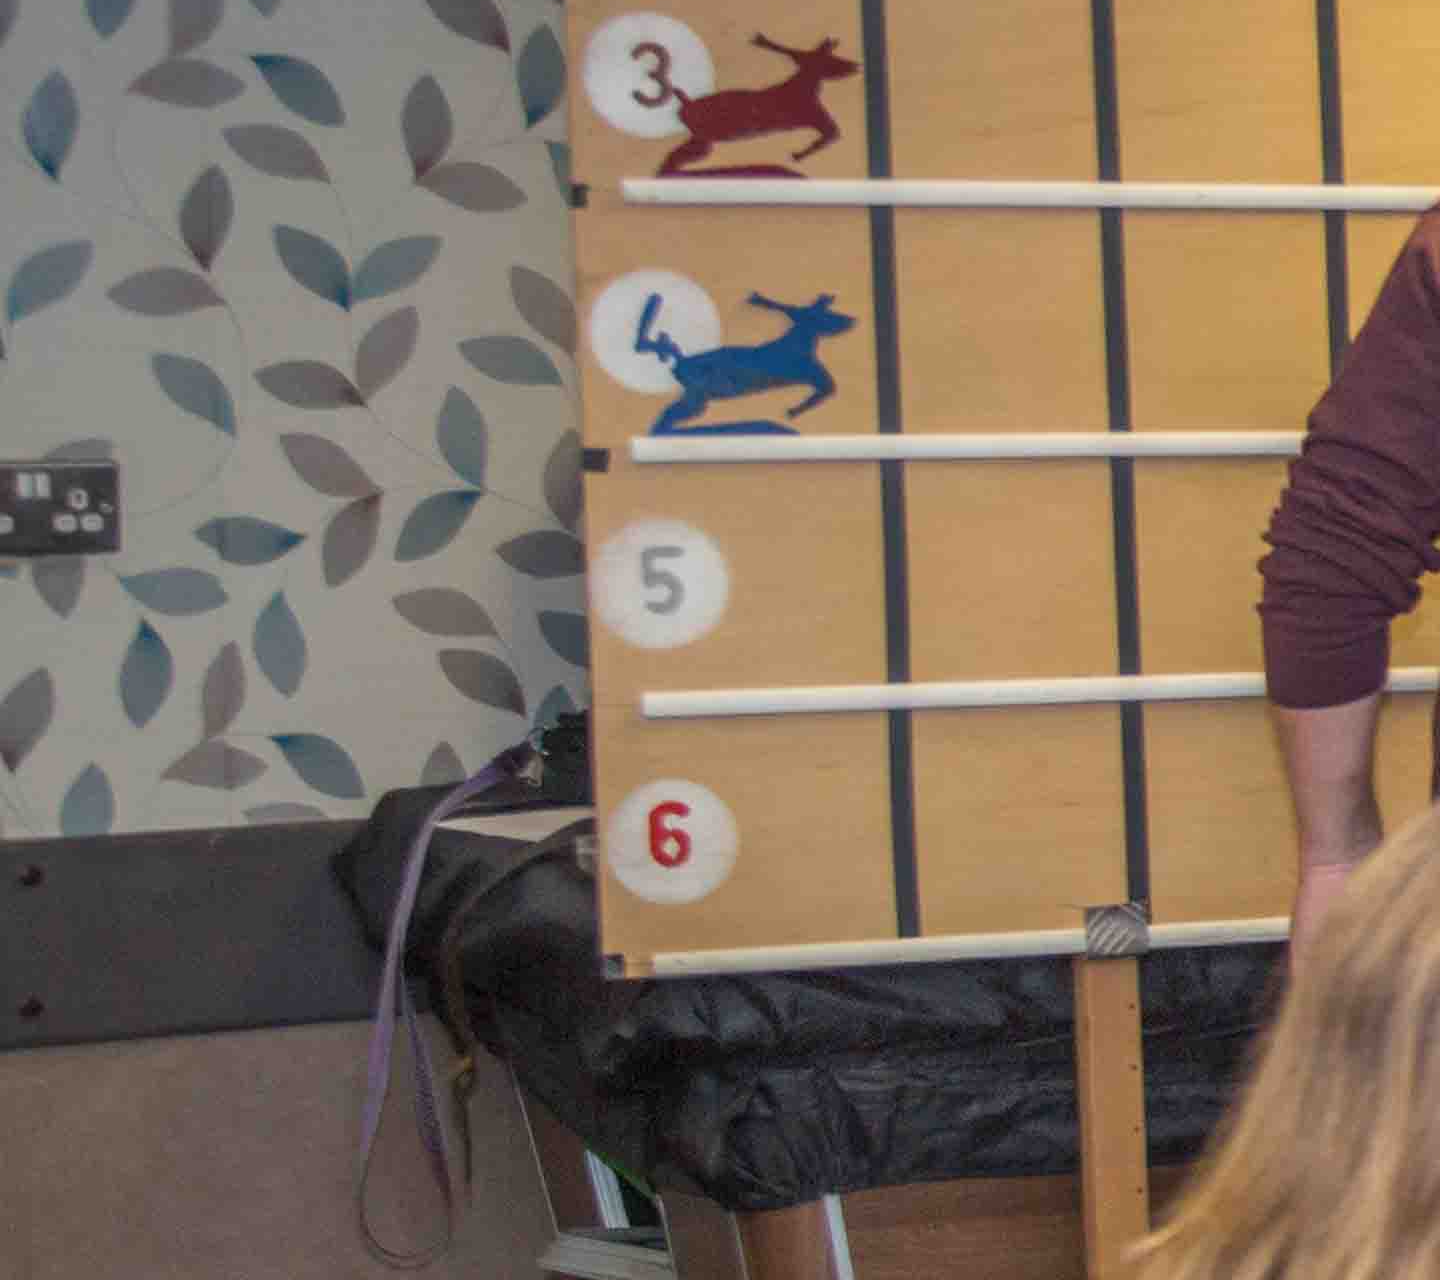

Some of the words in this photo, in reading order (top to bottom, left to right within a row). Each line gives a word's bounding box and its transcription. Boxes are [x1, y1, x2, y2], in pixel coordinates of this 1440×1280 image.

[628, 41, 674, 108] 3
[633, 292, 677, 363] 4
[639, 545, 687, 614] 5
[647, 801, 692, 868] 6
